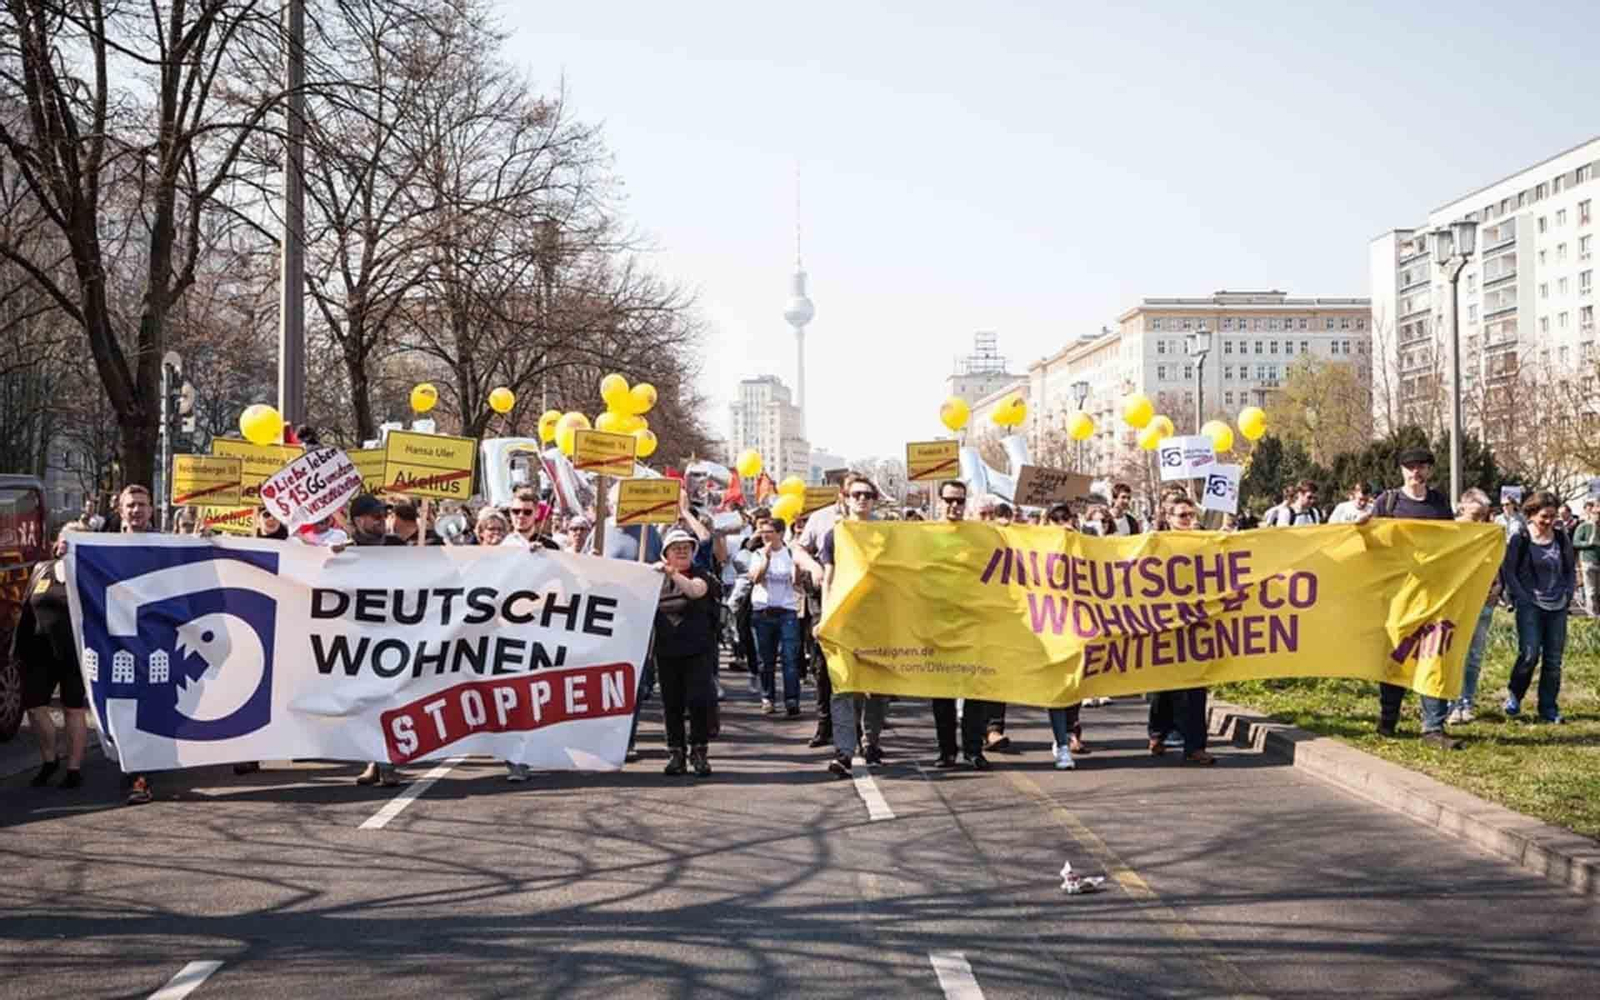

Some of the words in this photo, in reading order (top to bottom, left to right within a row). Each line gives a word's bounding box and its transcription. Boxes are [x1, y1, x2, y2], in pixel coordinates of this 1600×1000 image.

[274, 466, 308, 493] Liebe
[306, 447, 339, 471] leben
[289, 484, 310, 507] 15
[305, 472, 327, 495] GG
[394, 470, 461, 494] Akelius
[1044, 551, 1253, 600] DEUTSCHE
[310, 587, 618, 637] DEUTSCHE
[1027, 593, 1209, 639] WOHNEN
[1259, 571, 1317, 609] CO
[309, 634, 567, 679] WOHNEN
[1083, 614, 1299, 678] ENTEIGNEN
[390, 670, 626, 758] STOPPEN
